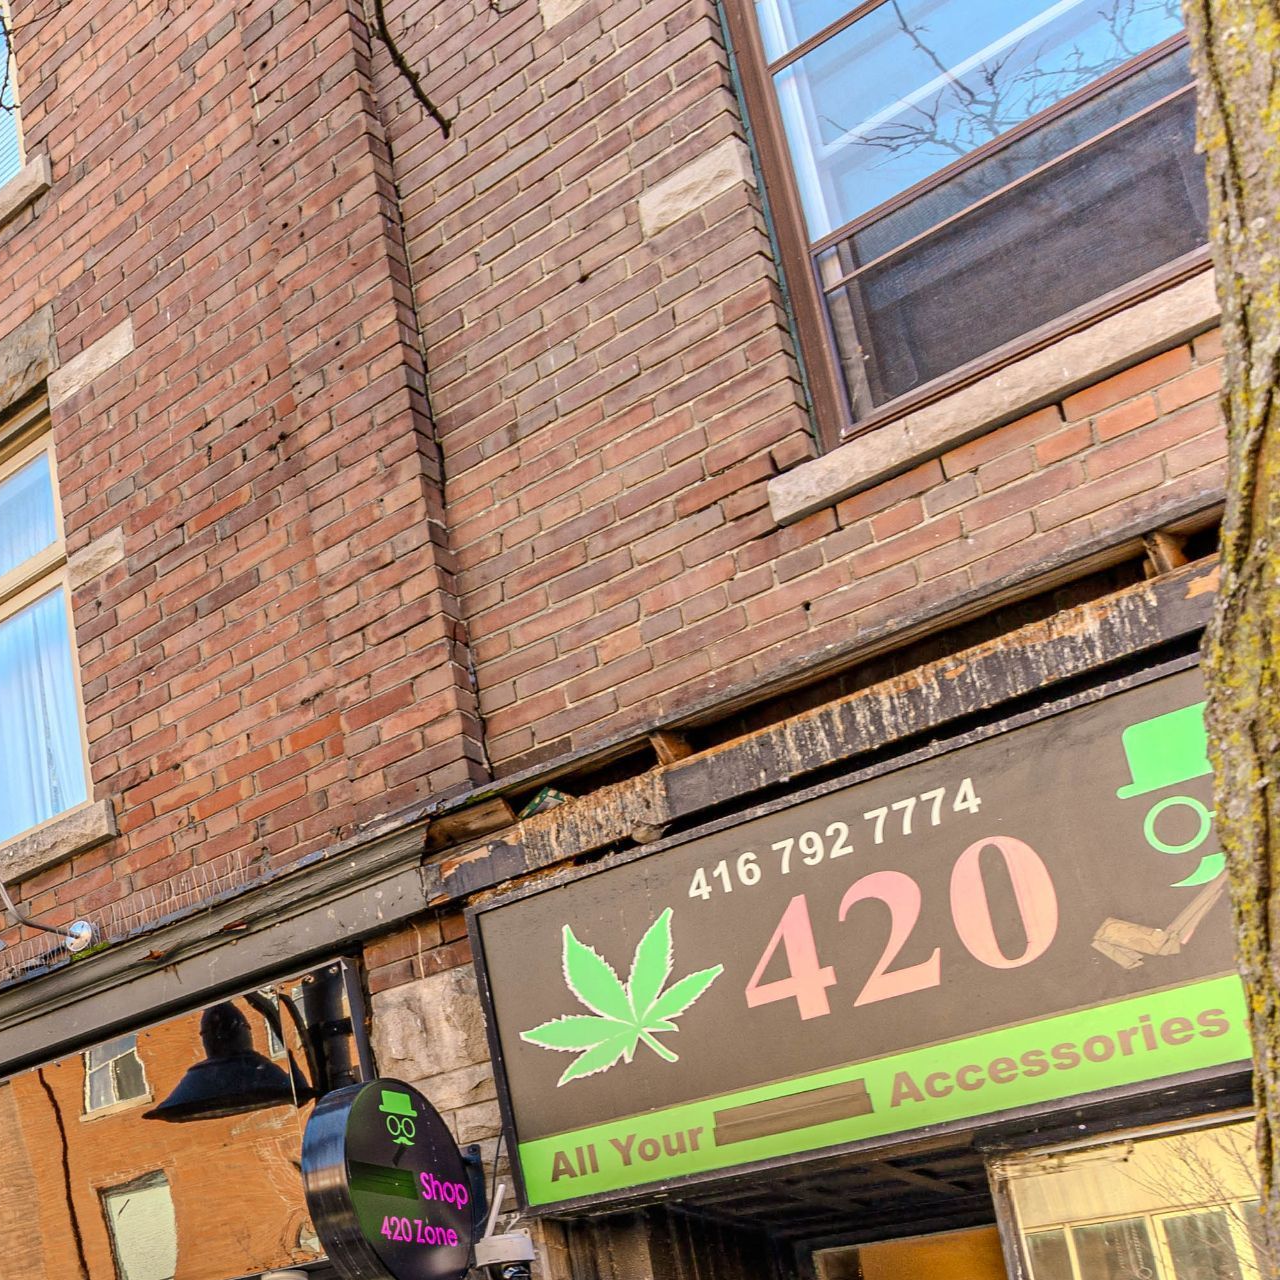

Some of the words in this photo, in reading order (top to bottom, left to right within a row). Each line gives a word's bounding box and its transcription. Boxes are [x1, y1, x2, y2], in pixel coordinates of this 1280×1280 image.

[688, 852, 762, 901] 416
[771, 820, 854, 876] 792
[863, 777, 983, 846] 7774
[744, 835, 1060, 1022] 420
[549, 1140, 599, 1185] All
[608, 1122, 706, 1167] Your
[888, 1003, 1231, 1108] Accessories
[380, 1215, 414, 1243] 420
[415, 1219, 459, 1247] Zone
[419, 1171, 469, 1209] Shop
